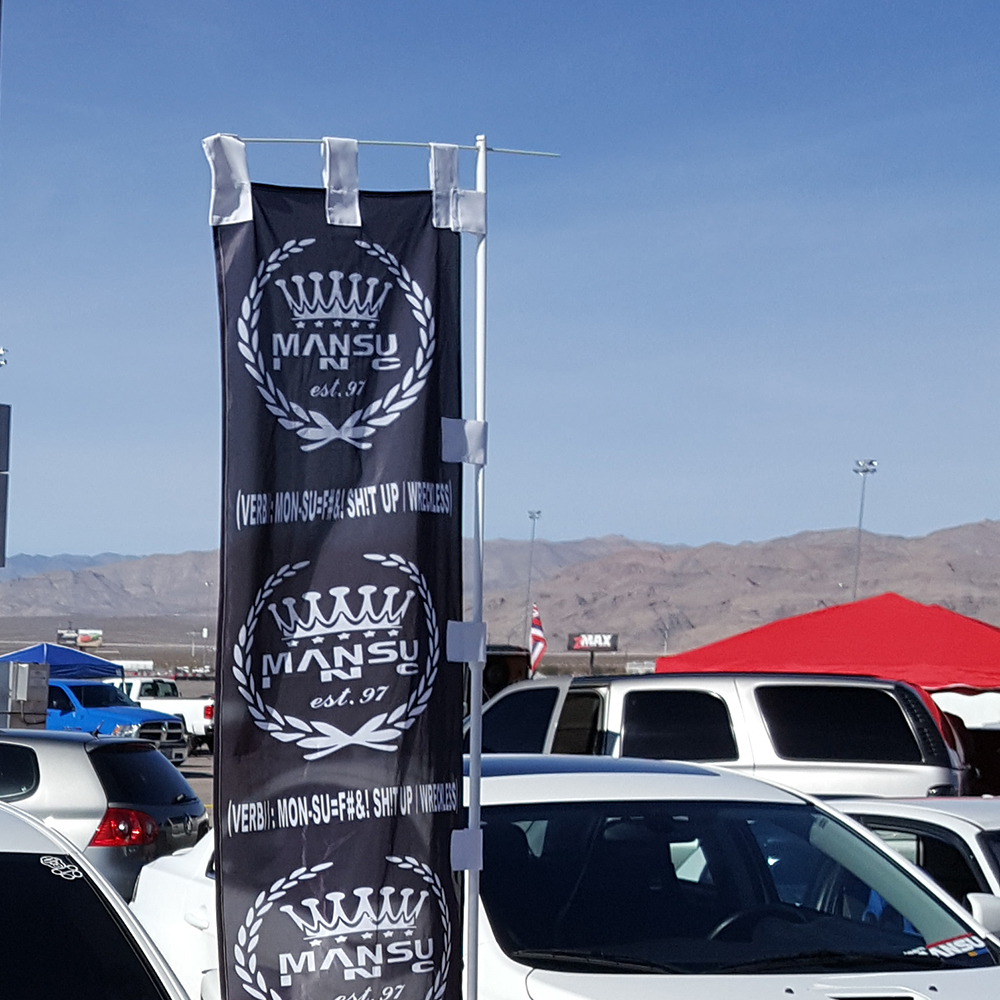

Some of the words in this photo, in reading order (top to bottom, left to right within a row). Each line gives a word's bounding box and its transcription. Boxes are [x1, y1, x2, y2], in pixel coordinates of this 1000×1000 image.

[272, 333, 398, 356] MANSU
[347, 483, 378, 519] SH!T
[380, 482, 400, 514] UP
[262, 639, 419, 676] MANSU
[372, 786, 398, 818] SH!T
[399, 785, 412, 815] UP
[279, 938, 434, 975] MANSU
